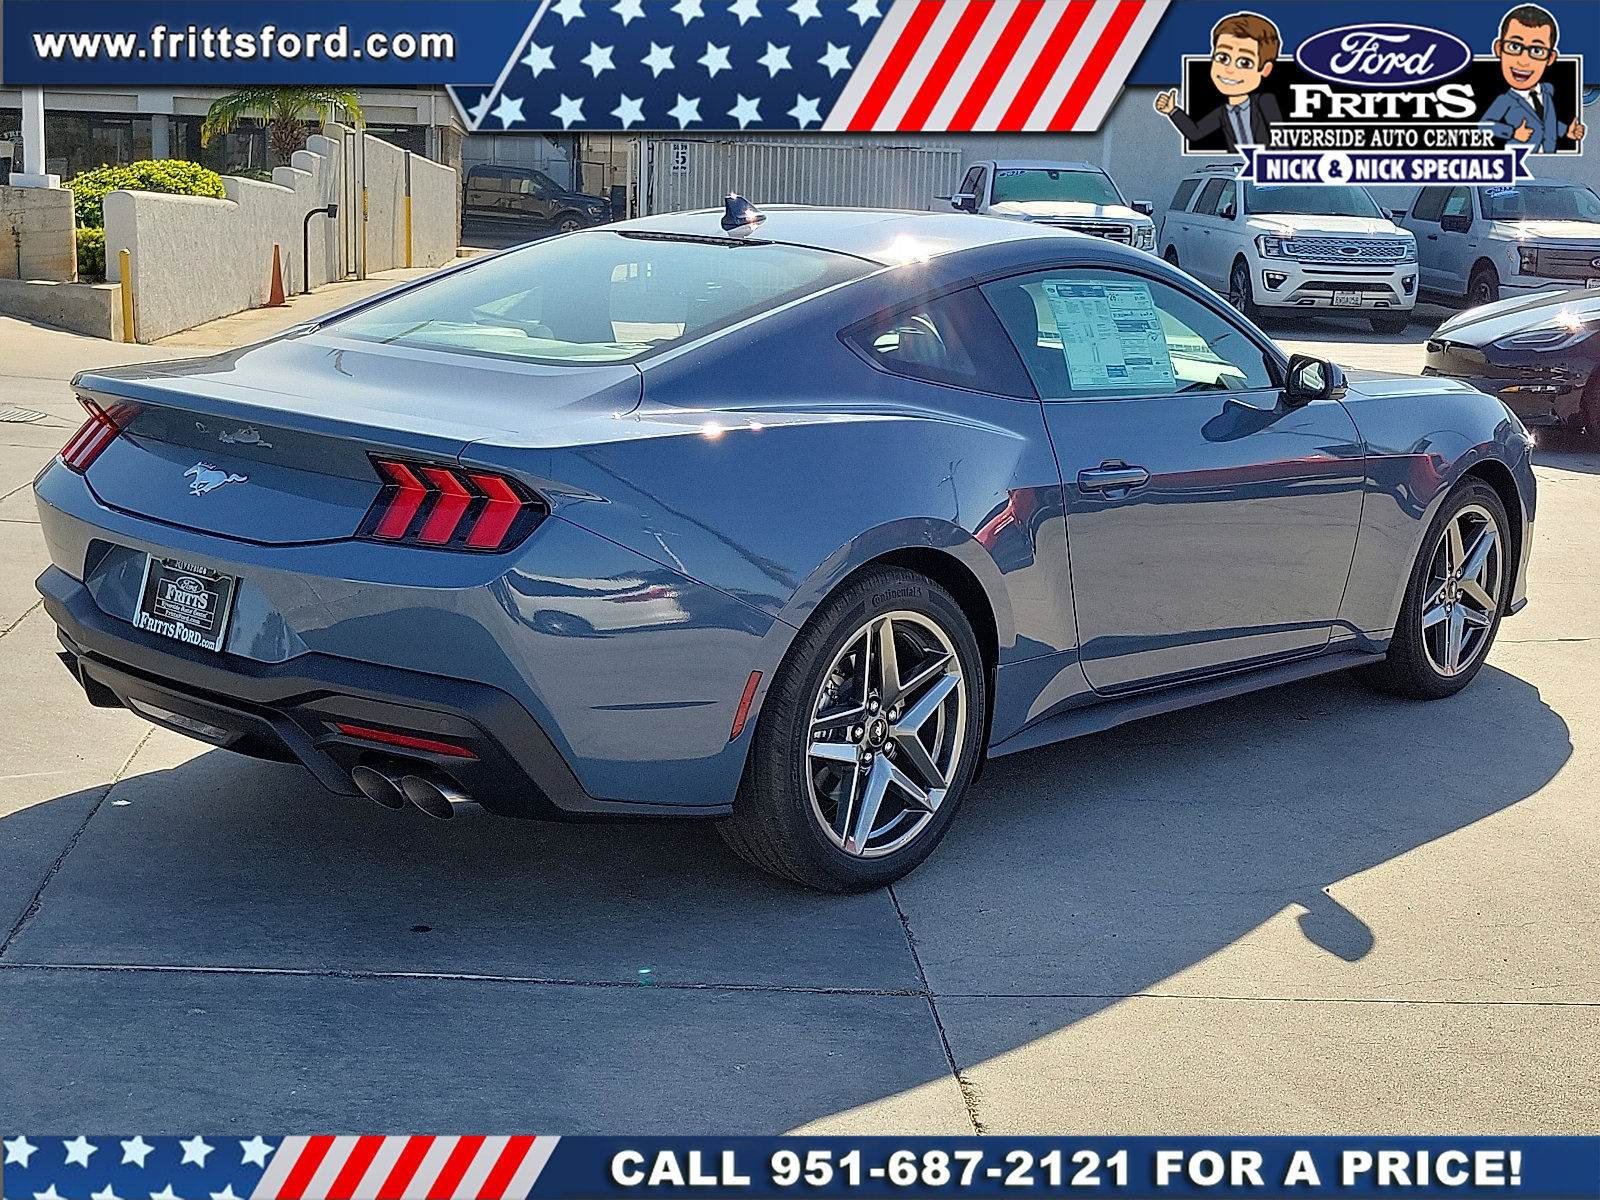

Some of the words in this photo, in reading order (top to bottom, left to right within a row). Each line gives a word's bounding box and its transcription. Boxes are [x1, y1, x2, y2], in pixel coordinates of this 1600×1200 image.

[180, 579, 199, 592] Ford
[165, 583, 208, 610] FRITTS
[872, 587, 916, 608] Continental
